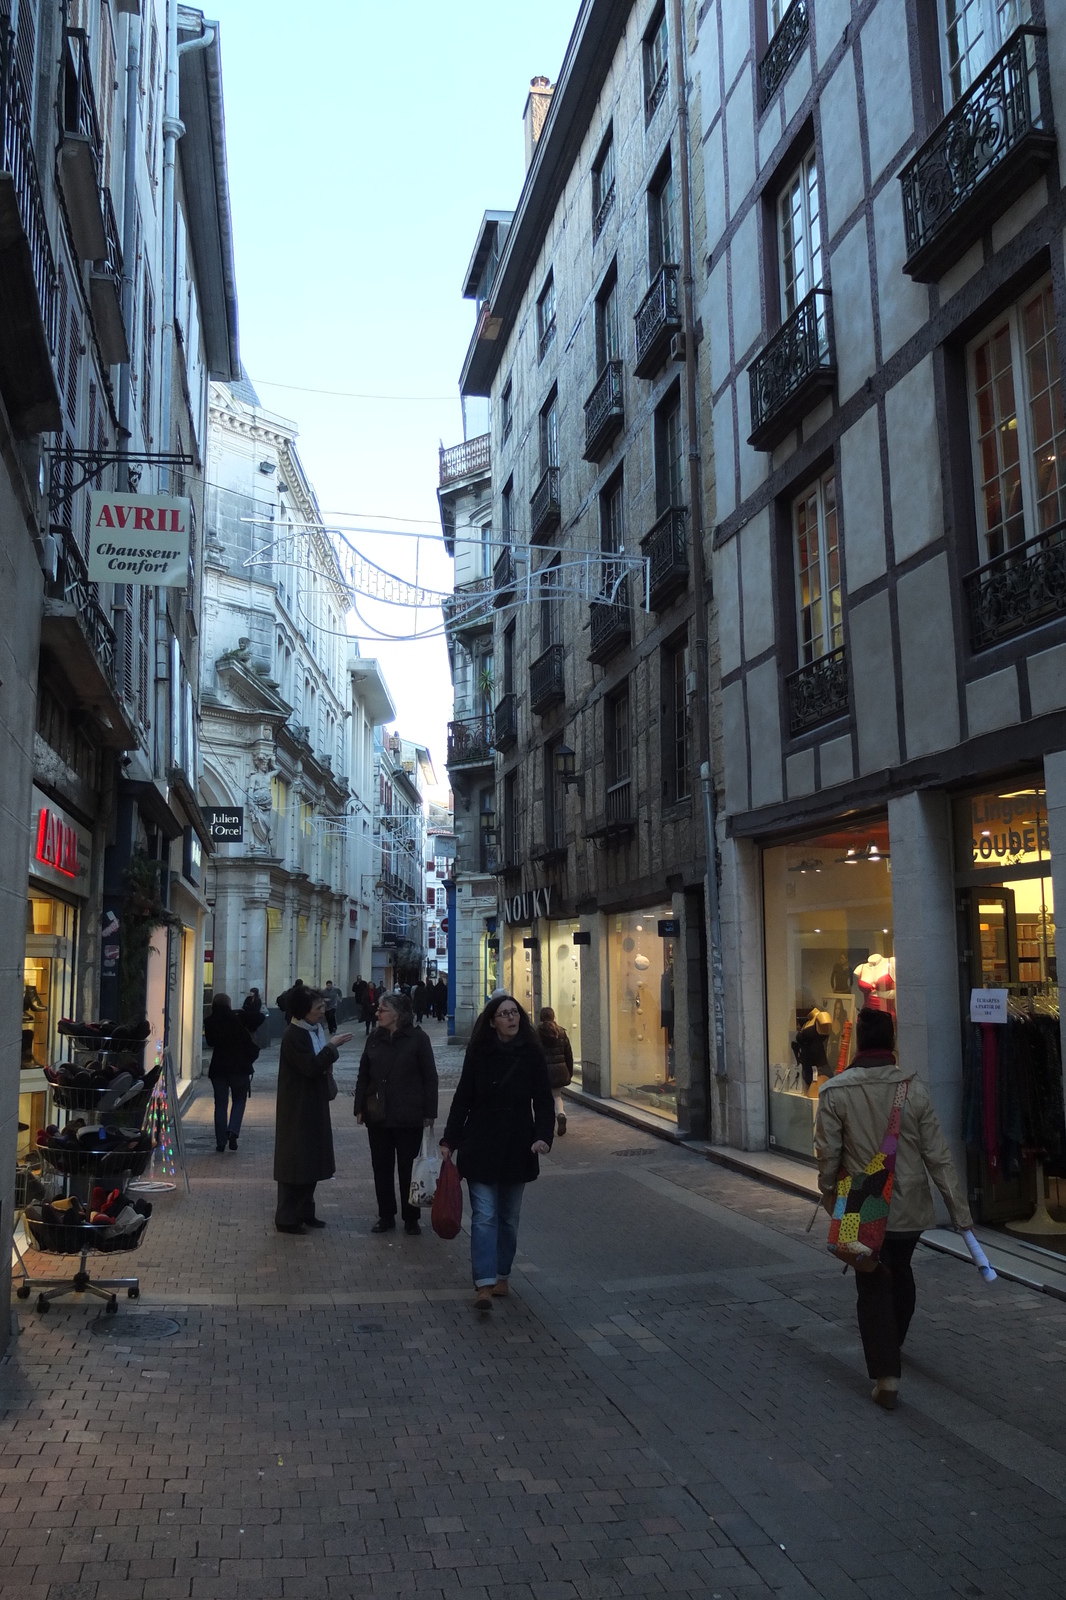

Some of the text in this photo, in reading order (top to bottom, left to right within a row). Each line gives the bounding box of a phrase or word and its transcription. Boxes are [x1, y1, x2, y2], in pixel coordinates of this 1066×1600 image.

[96, 504, 185, 533] AVRIL
[96, 543, 181, 560] Chausseur
[108, 558, 169, 575] Confort
[210, 813, 239, 825] Julien
[504, 886, 552, 923] NOUKY
